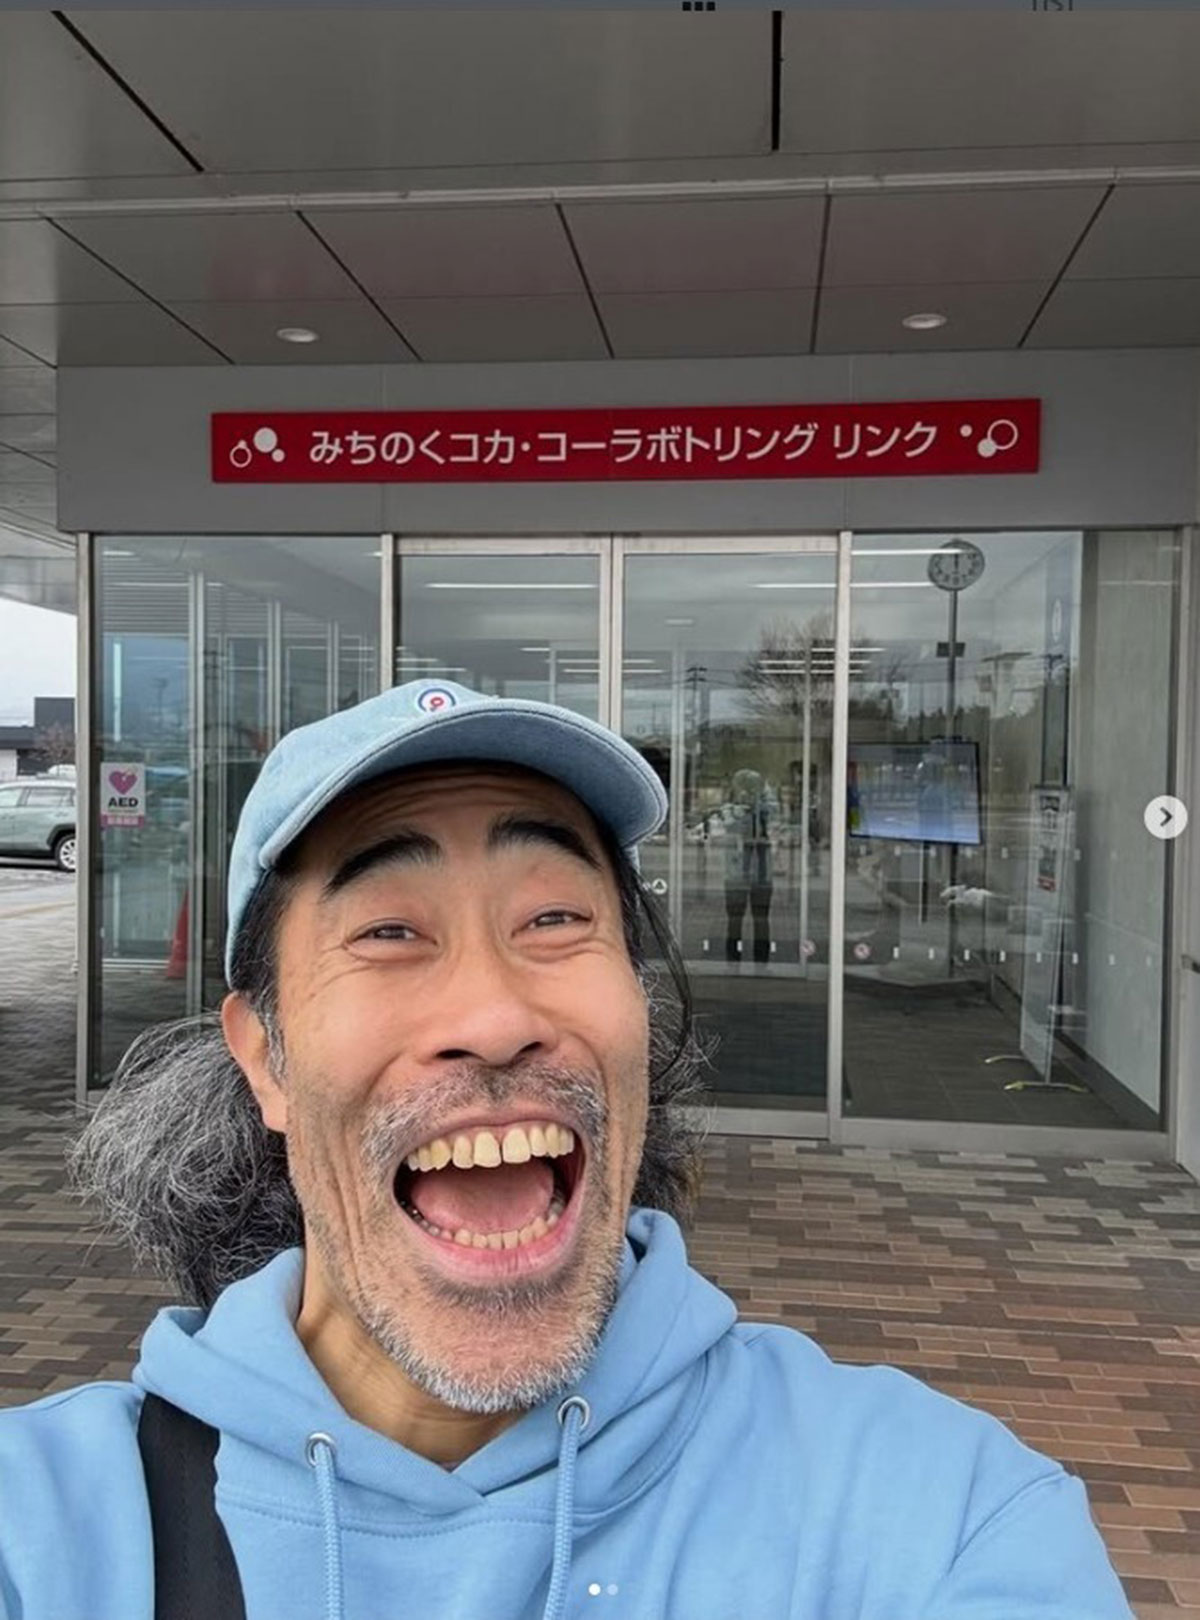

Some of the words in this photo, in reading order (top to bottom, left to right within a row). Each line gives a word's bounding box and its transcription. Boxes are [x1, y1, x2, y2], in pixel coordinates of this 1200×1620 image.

[309, 422, 819, 466] みちのくコカ・コーラボトリング
[833, 420, 938, 460] リンク
[108, 796, 138, 808] AED
